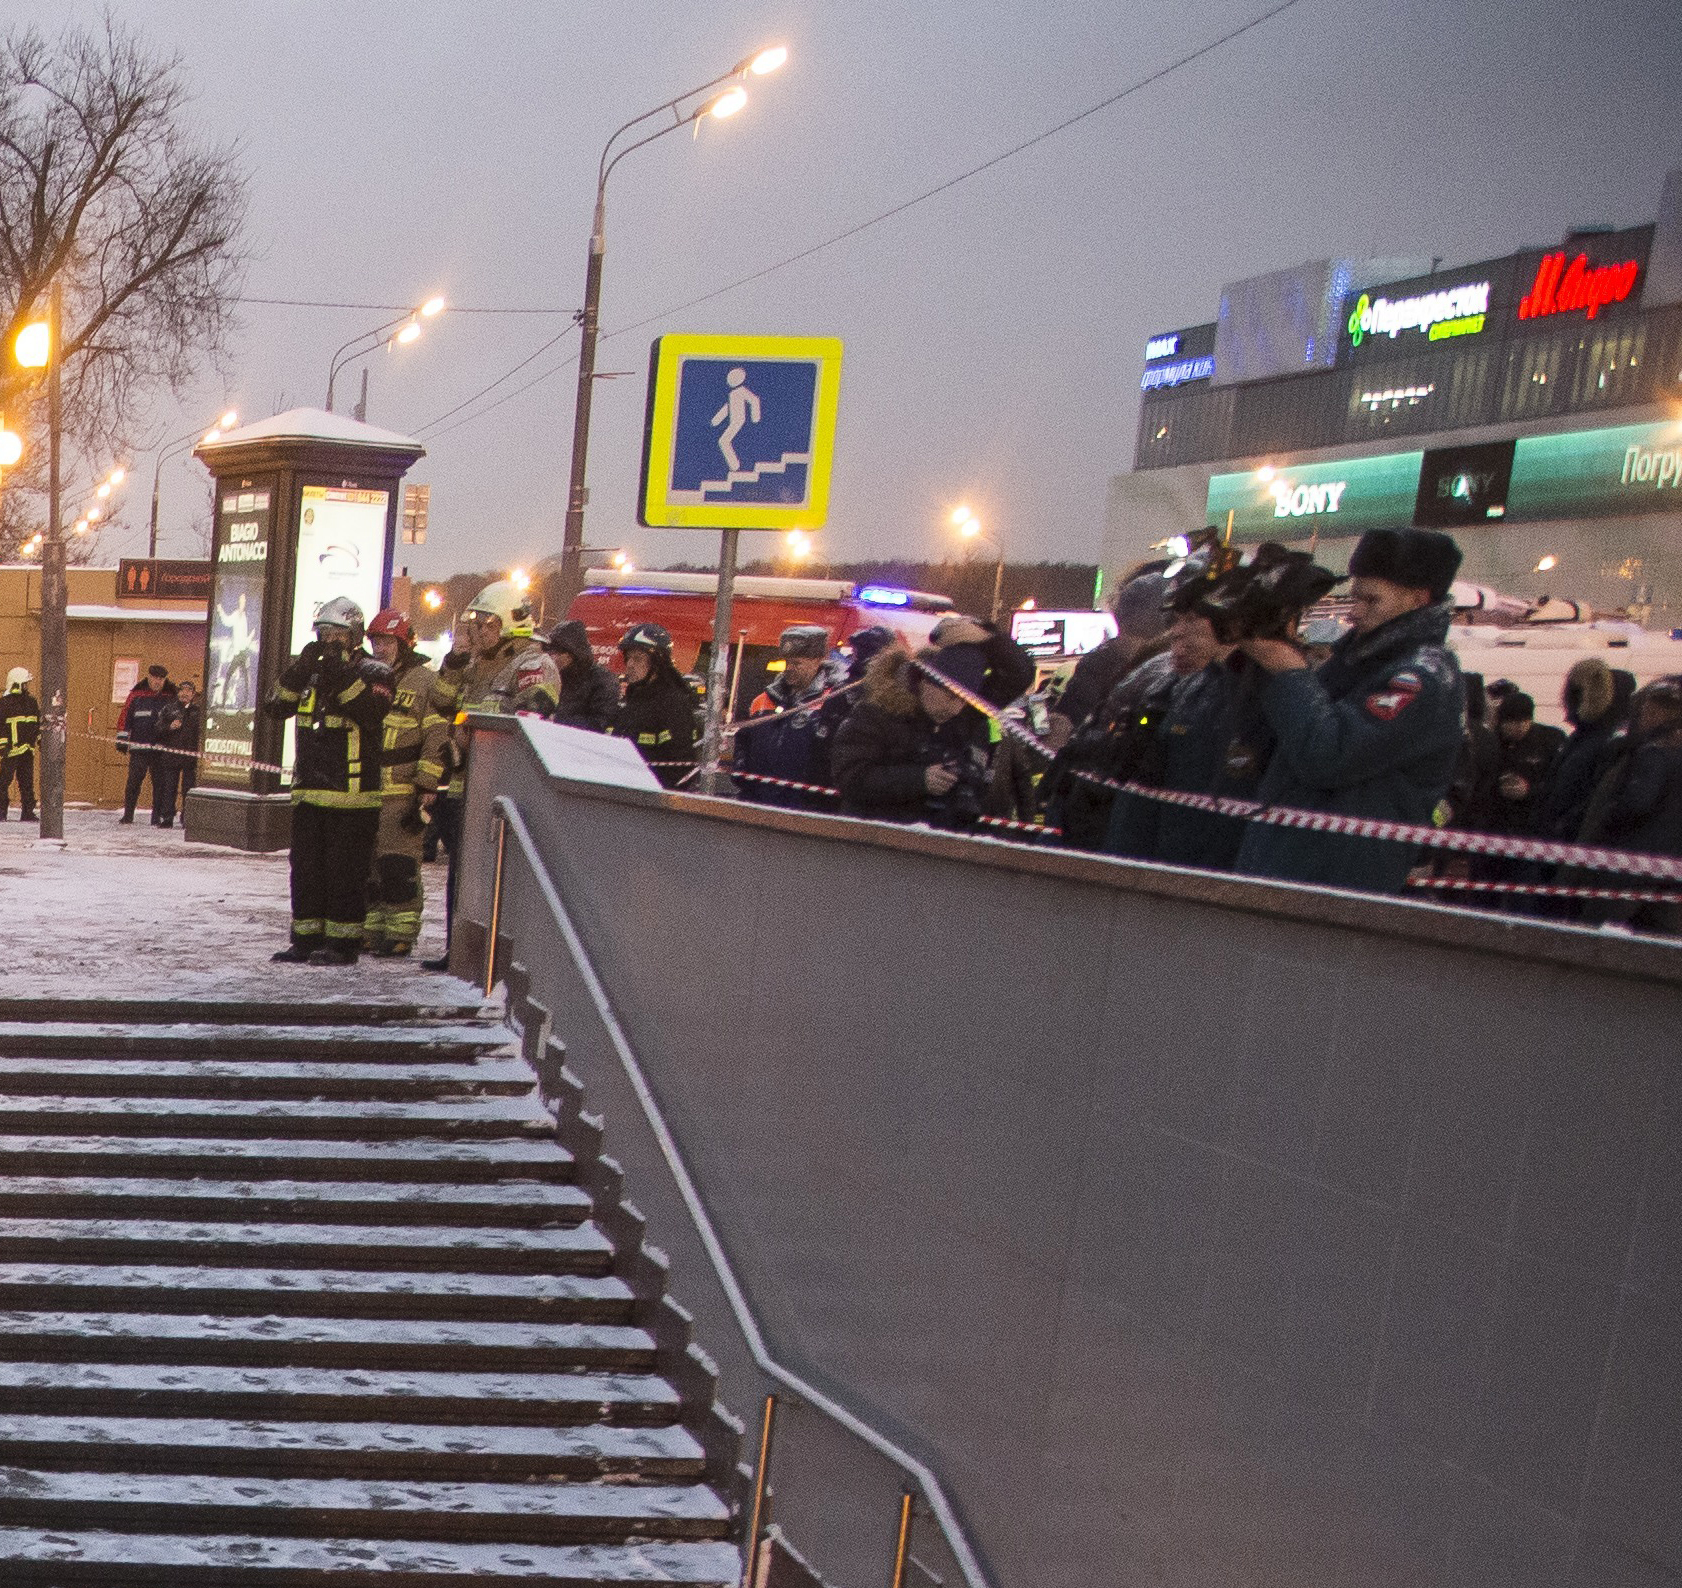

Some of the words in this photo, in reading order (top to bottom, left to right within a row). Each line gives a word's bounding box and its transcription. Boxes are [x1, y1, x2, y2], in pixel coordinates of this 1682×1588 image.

[1274, 482, 1346, 518] SONY
[230, 522, 259, 542] BIAGIO
[218, 541, 268, 562] ANTONACCI
